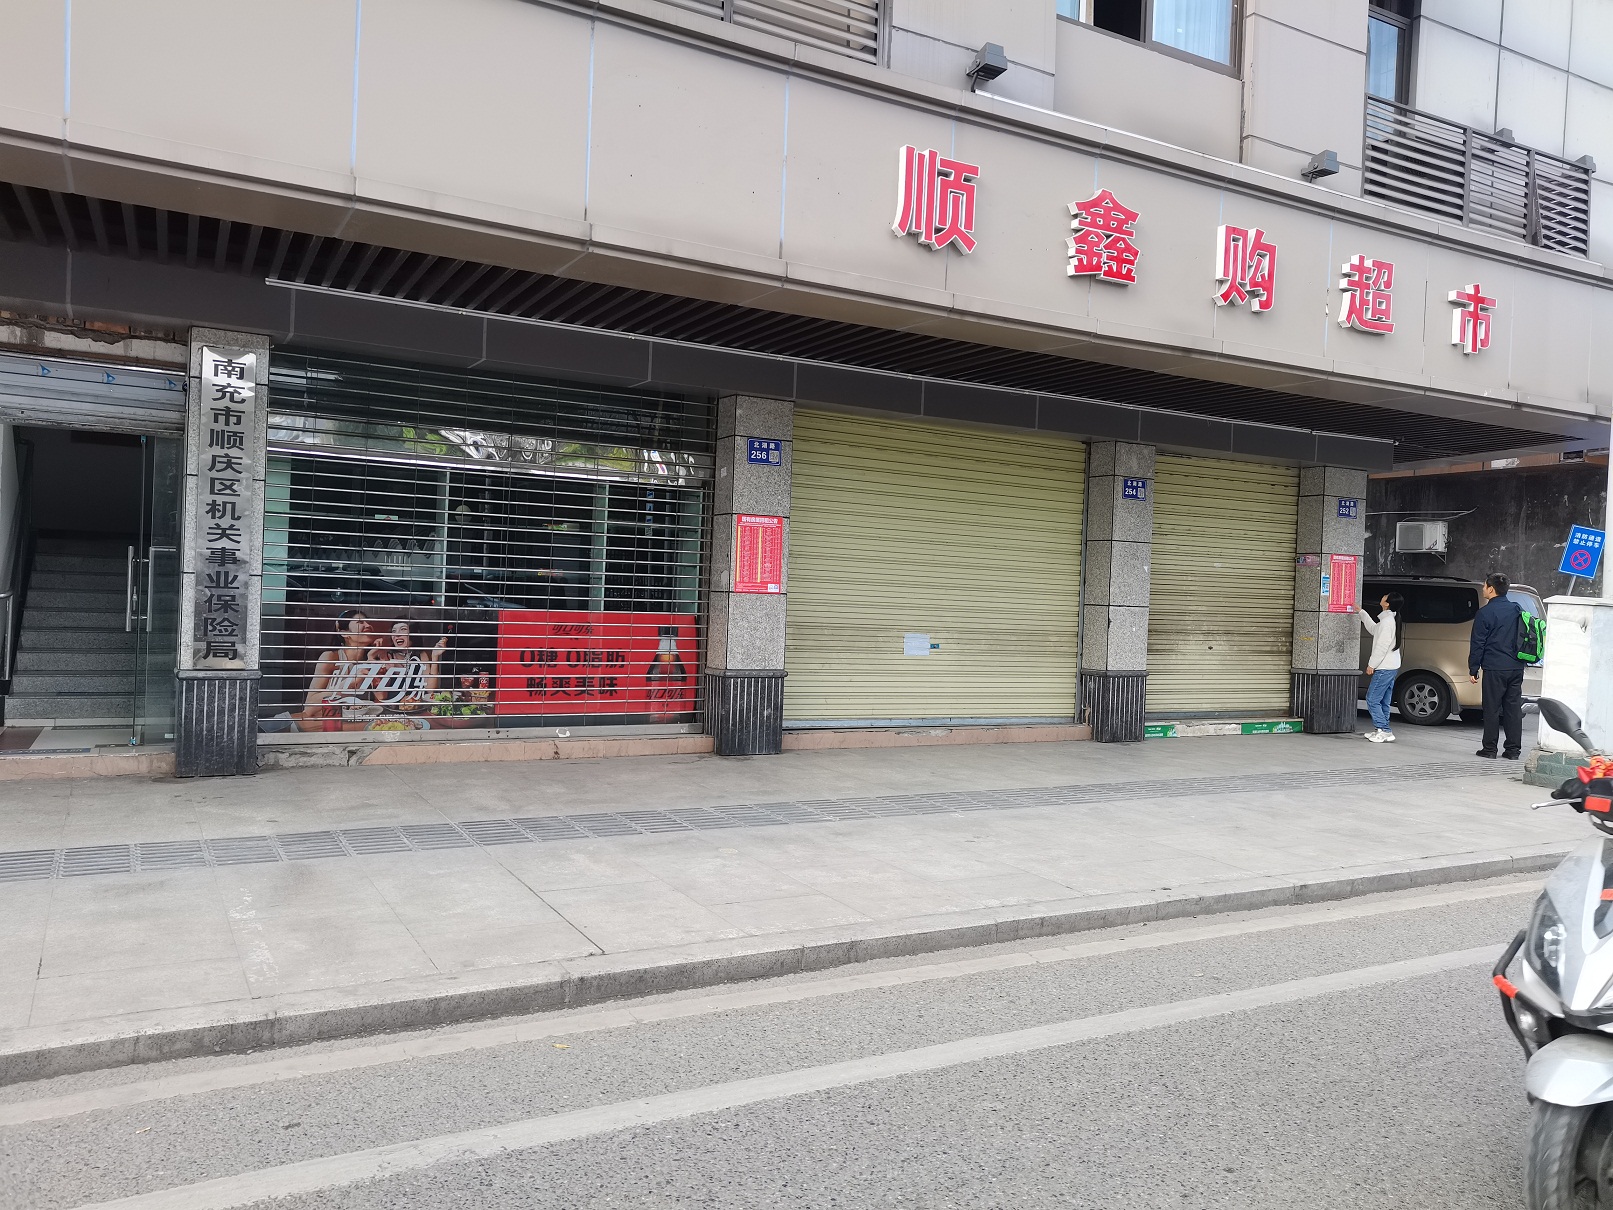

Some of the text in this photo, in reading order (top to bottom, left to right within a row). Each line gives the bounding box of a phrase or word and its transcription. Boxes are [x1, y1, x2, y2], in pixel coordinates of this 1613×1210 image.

[892, 144, 1498, 356] 顺鑫购超市
[751, 450, 767, 460] 256
[1125, 487, 1136, 495] 254
[201, 358, 247, 661] 南充市顺庆区机关事业保险局
[1573, 538, 1600, 548] 禁止停车
